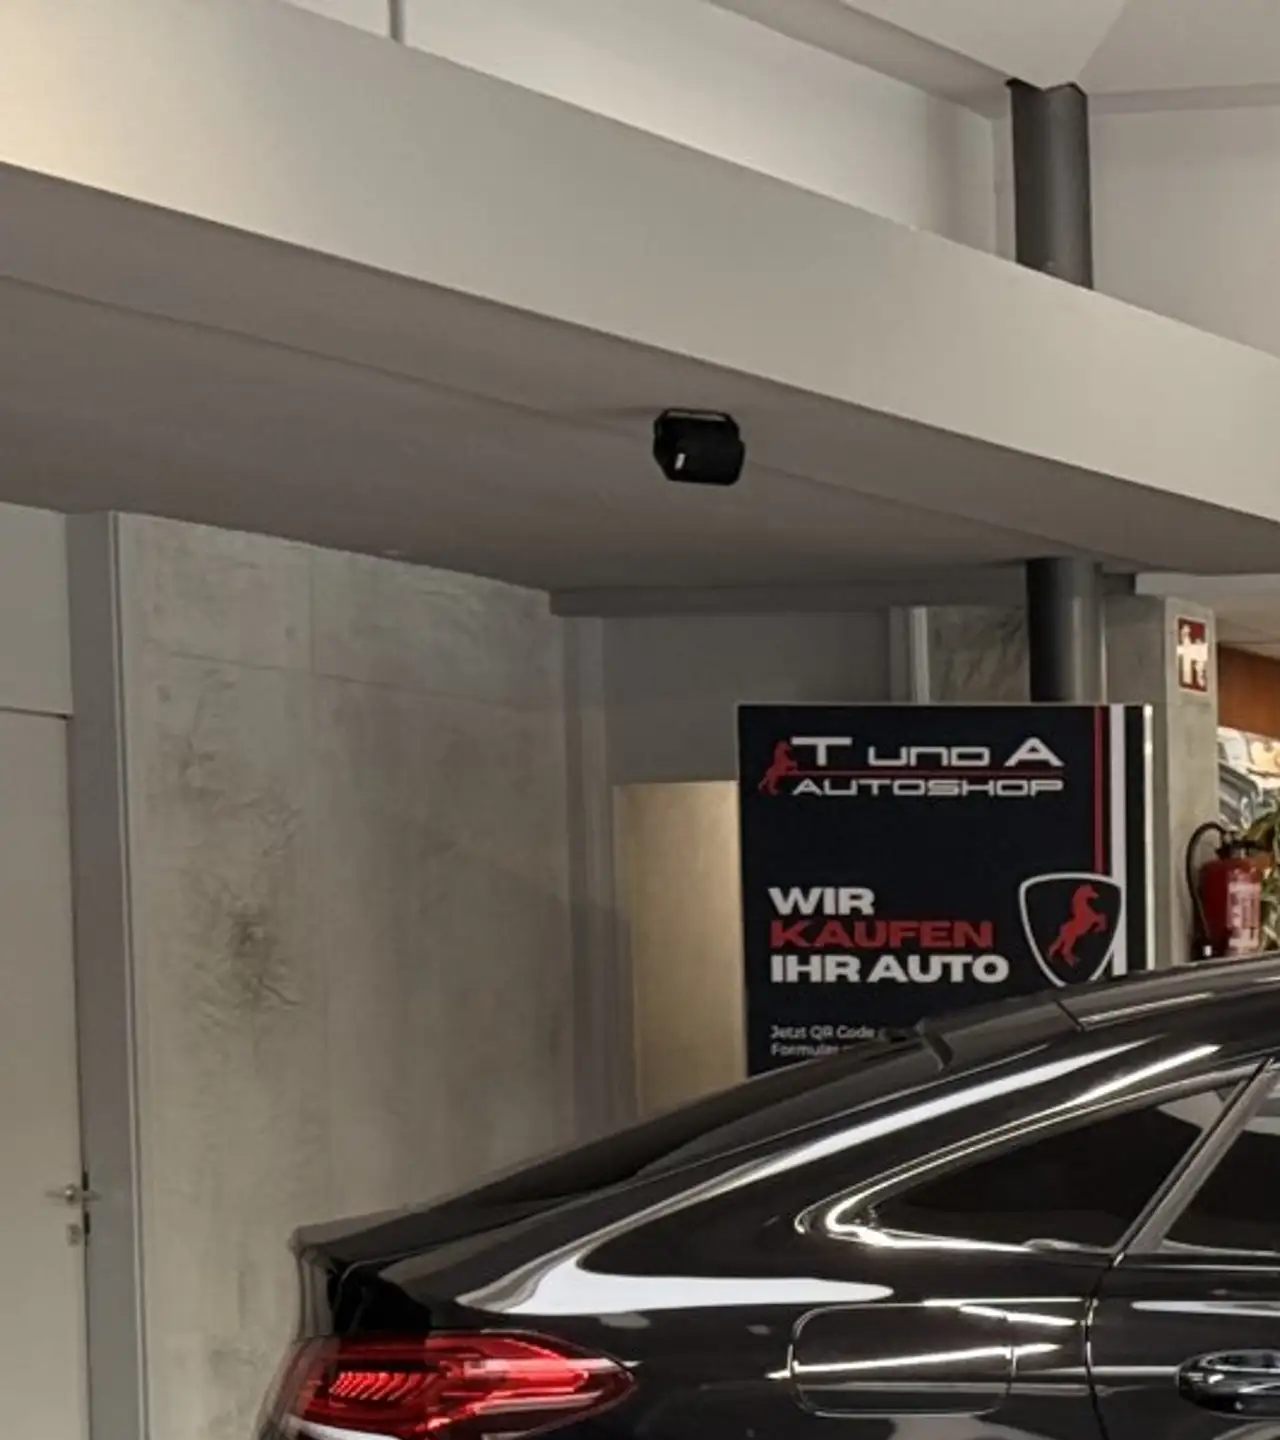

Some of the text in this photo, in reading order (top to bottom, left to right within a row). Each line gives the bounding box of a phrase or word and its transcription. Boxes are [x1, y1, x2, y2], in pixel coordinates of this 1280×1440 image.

[790, 736, 853, 767] T
[1003, 736, 1065, 767] A
[792, 777, 1065, 797] AUTOSHOP
[768, 886, 876, 916] WIR
[770, 919, 995, 949] KAUFEN
[770, 953, 1010, 984] IHR AUTO
[769, 1023, 807, 1040] Jetzt
[808, 1023, 835, 1041] QR
[836, 1024, 875, 1040] Code
[769, 1042, 840, 1057] Formular
